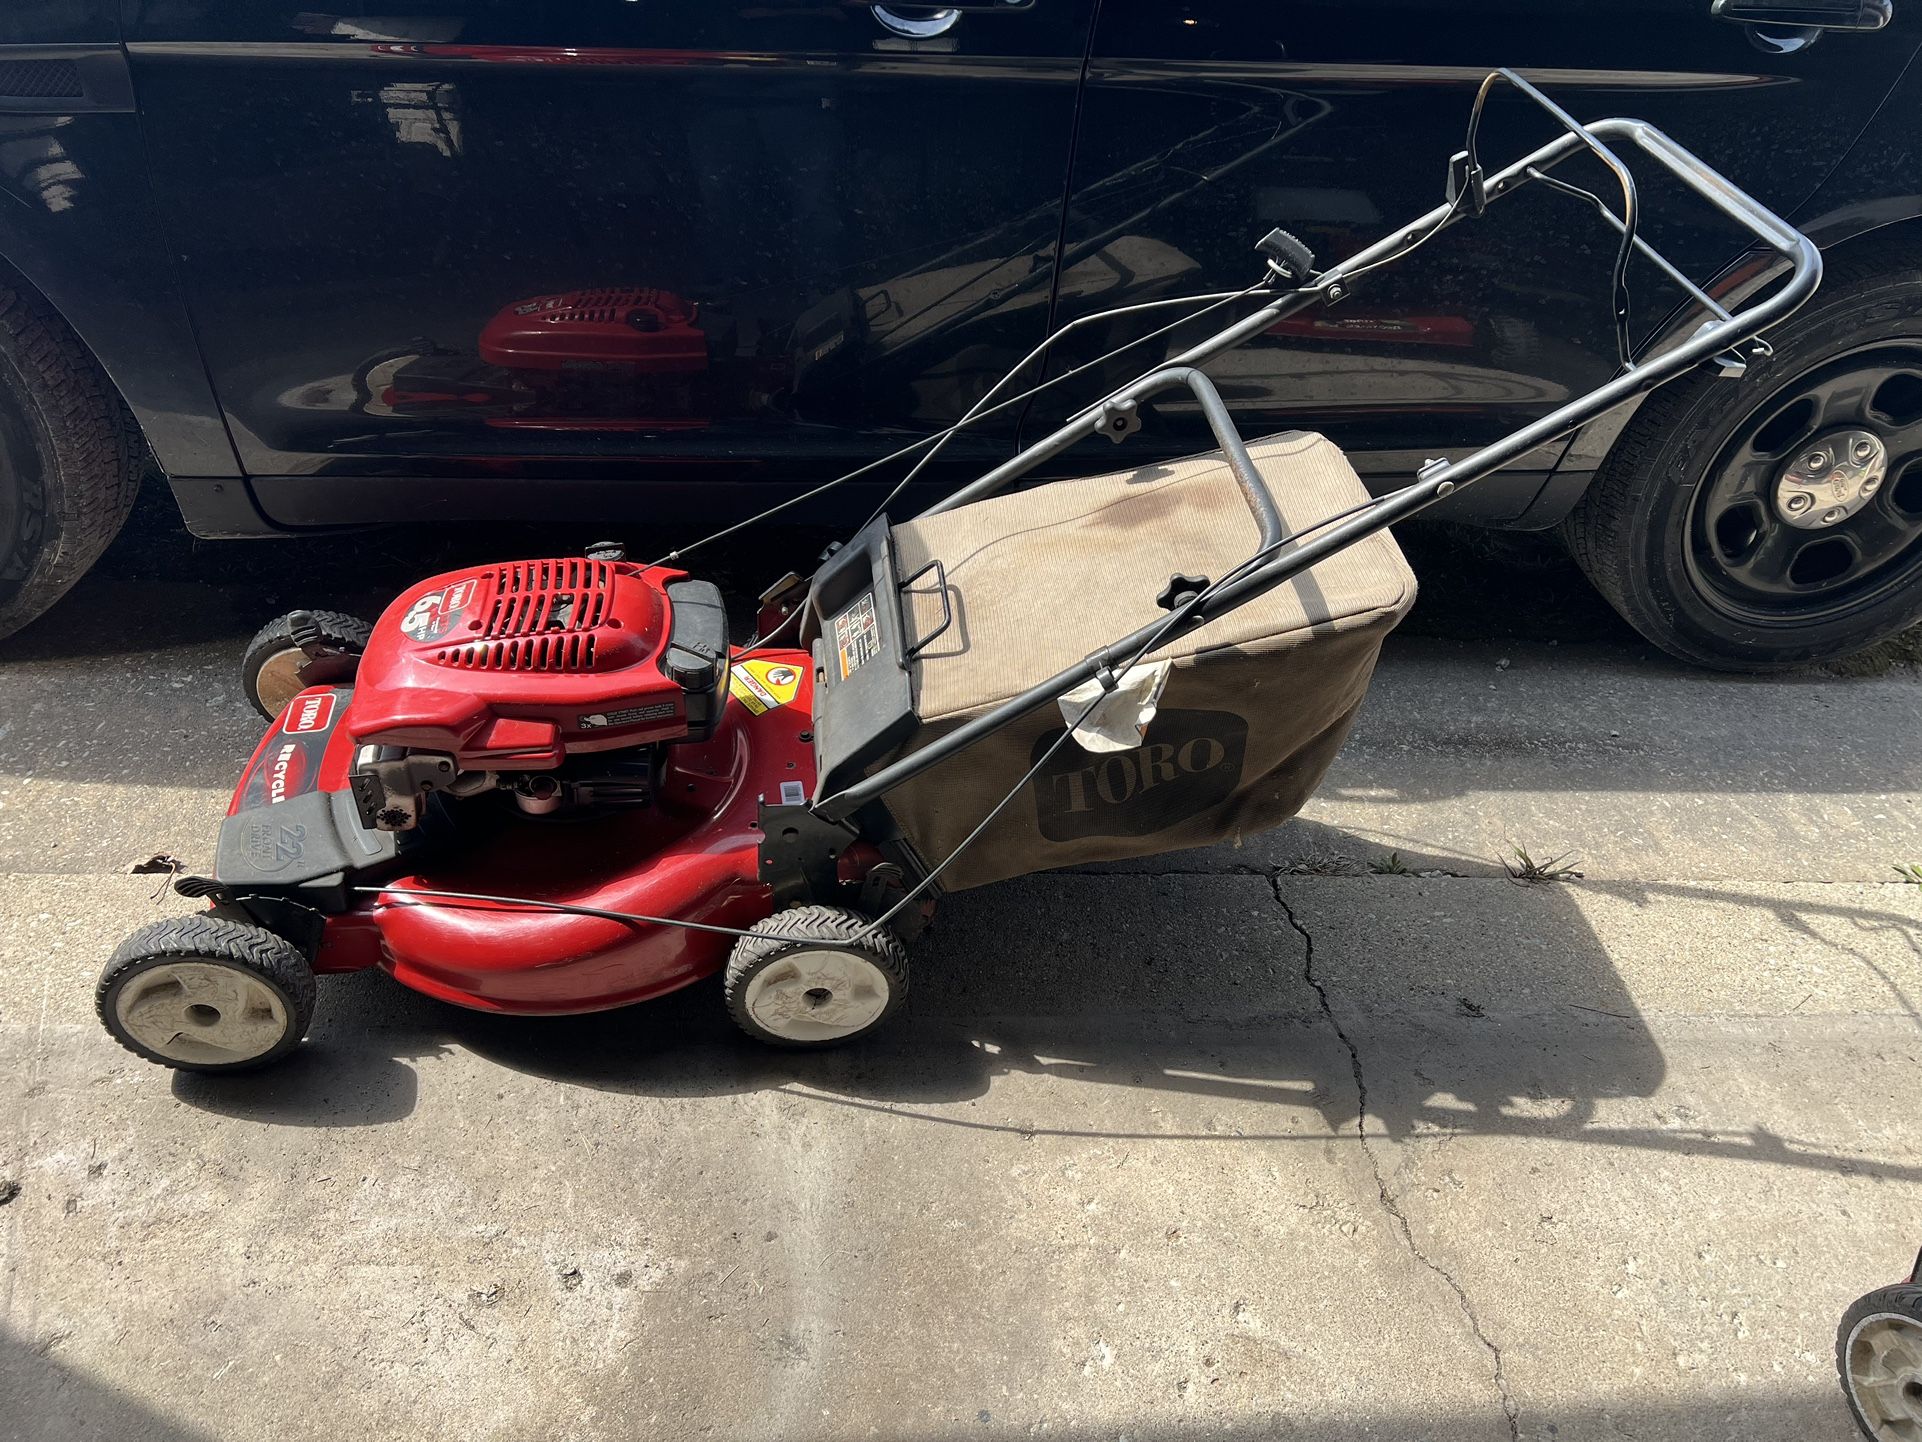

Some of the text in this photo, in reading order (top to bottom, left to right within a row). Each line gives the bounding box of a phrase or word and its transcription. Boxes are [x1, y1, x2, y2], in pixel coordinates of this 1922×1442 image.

[448, 584, 467, 610] TORO
[416, 624, 426, 640] HP
[743, 675, 767, 697] DANGER
[297, 697, 323, 731] TORO
[1052, 737, 1226, 814] TORO
[250, 824, 261, 860] DRIVE
[261, 824, 274, 861] FRONT
